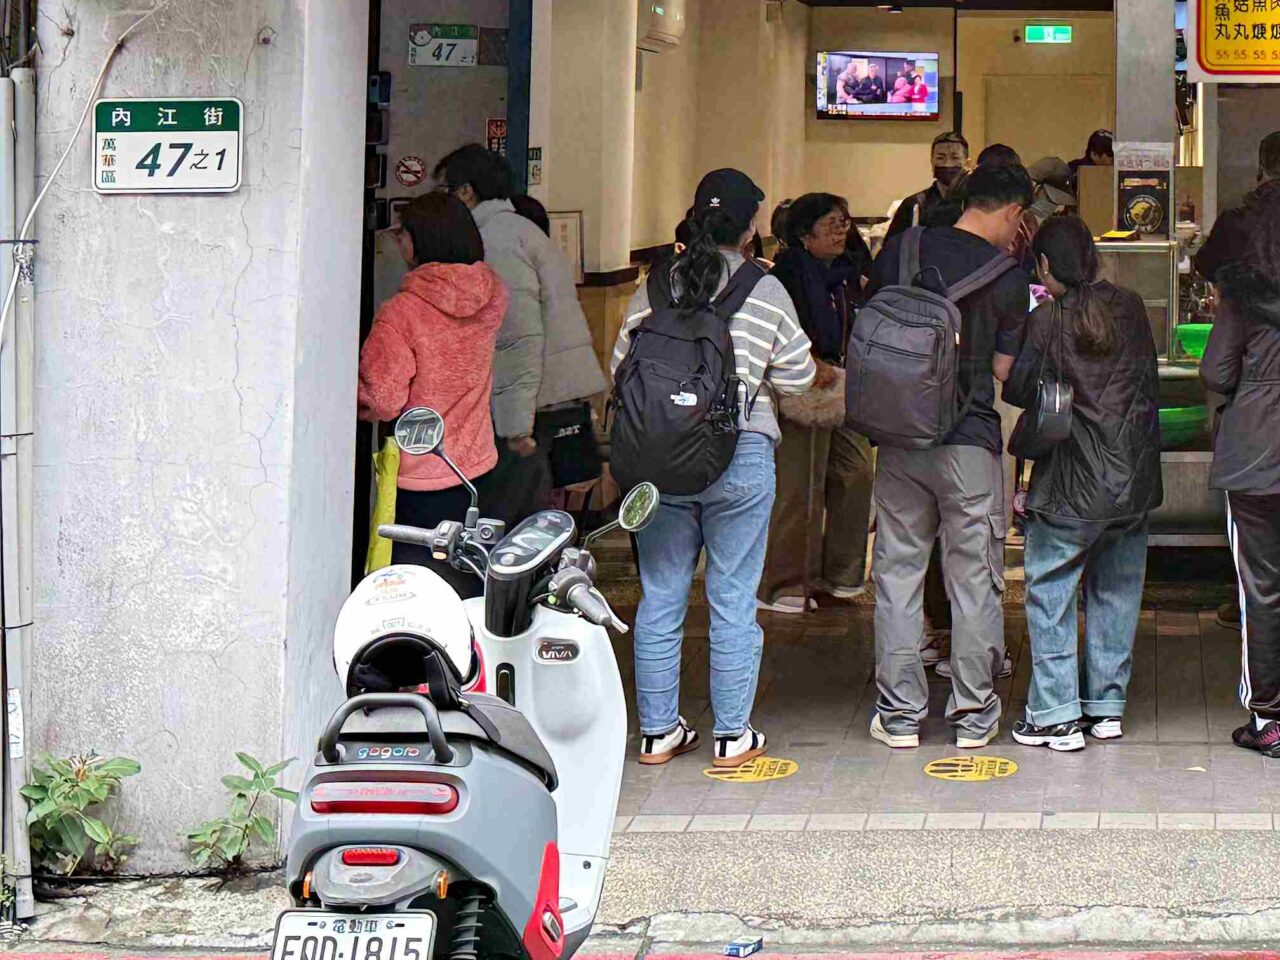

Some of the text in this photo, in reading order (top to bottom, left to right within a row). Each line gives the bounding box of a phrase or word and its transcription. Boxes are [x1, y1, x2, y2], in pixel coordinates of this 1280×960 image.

[112, 107, 223, 126] 內江街
[101, 138, 116, 183] 萬華區
[135, 142, 226, 177] 47之1
[357, 747, 420, 759] gogoro
